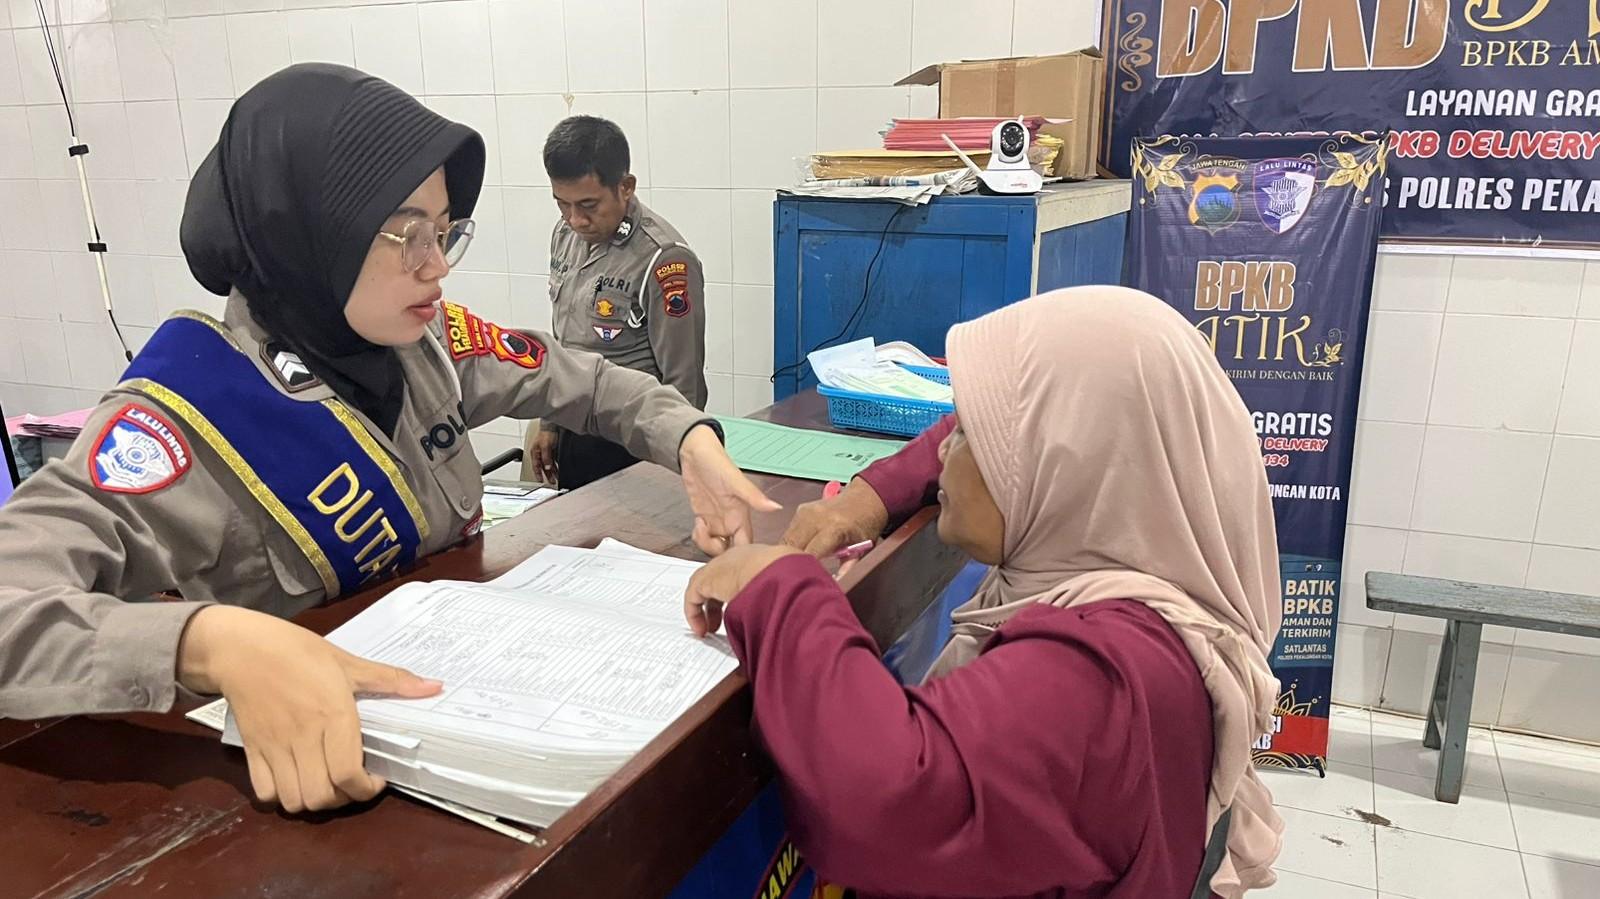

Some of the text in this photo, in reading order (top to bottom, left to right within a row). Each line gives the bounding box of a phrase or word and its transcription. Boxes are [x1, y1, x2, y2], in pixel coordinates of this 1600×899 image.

[1460, 40, 1550, 67] BPKB
[1406, 89, 1537, 116] LAYANAN
[1447, 130, 1600, 160] DELIVERY
[1191, 159, 1247, 171] JAWA TENGAH
[1260, 161, 1313, 172] LALU LINTAS
[1398, 177, 1514, 211] POLRES
[1521, 178, 1600, 213] PEKA
[1194, 261, 1296, 312] BPKB
[1259, 370, 1306, 381] DENGAN
[1308, 371, 1335, 382] BAIK
[1251, 411, 1333, 436] GRATIS
[1264, 437, 1328, 452] DELIVERY
[1264, 454, 1290, 467] 134
[1309, 485, 1341, 501] KOTA
[307, 462, 402, 584] DUTA
[1285, 580, 1336, 596] BATIK
[1283, 598, 1333, 615] BPKB
[1282, 617, 1332, 627] AMAN DAN
[1282, 628, 1331, 639] TERKIRIM
[1284, 644, 1327, 654] SATLANTAS
